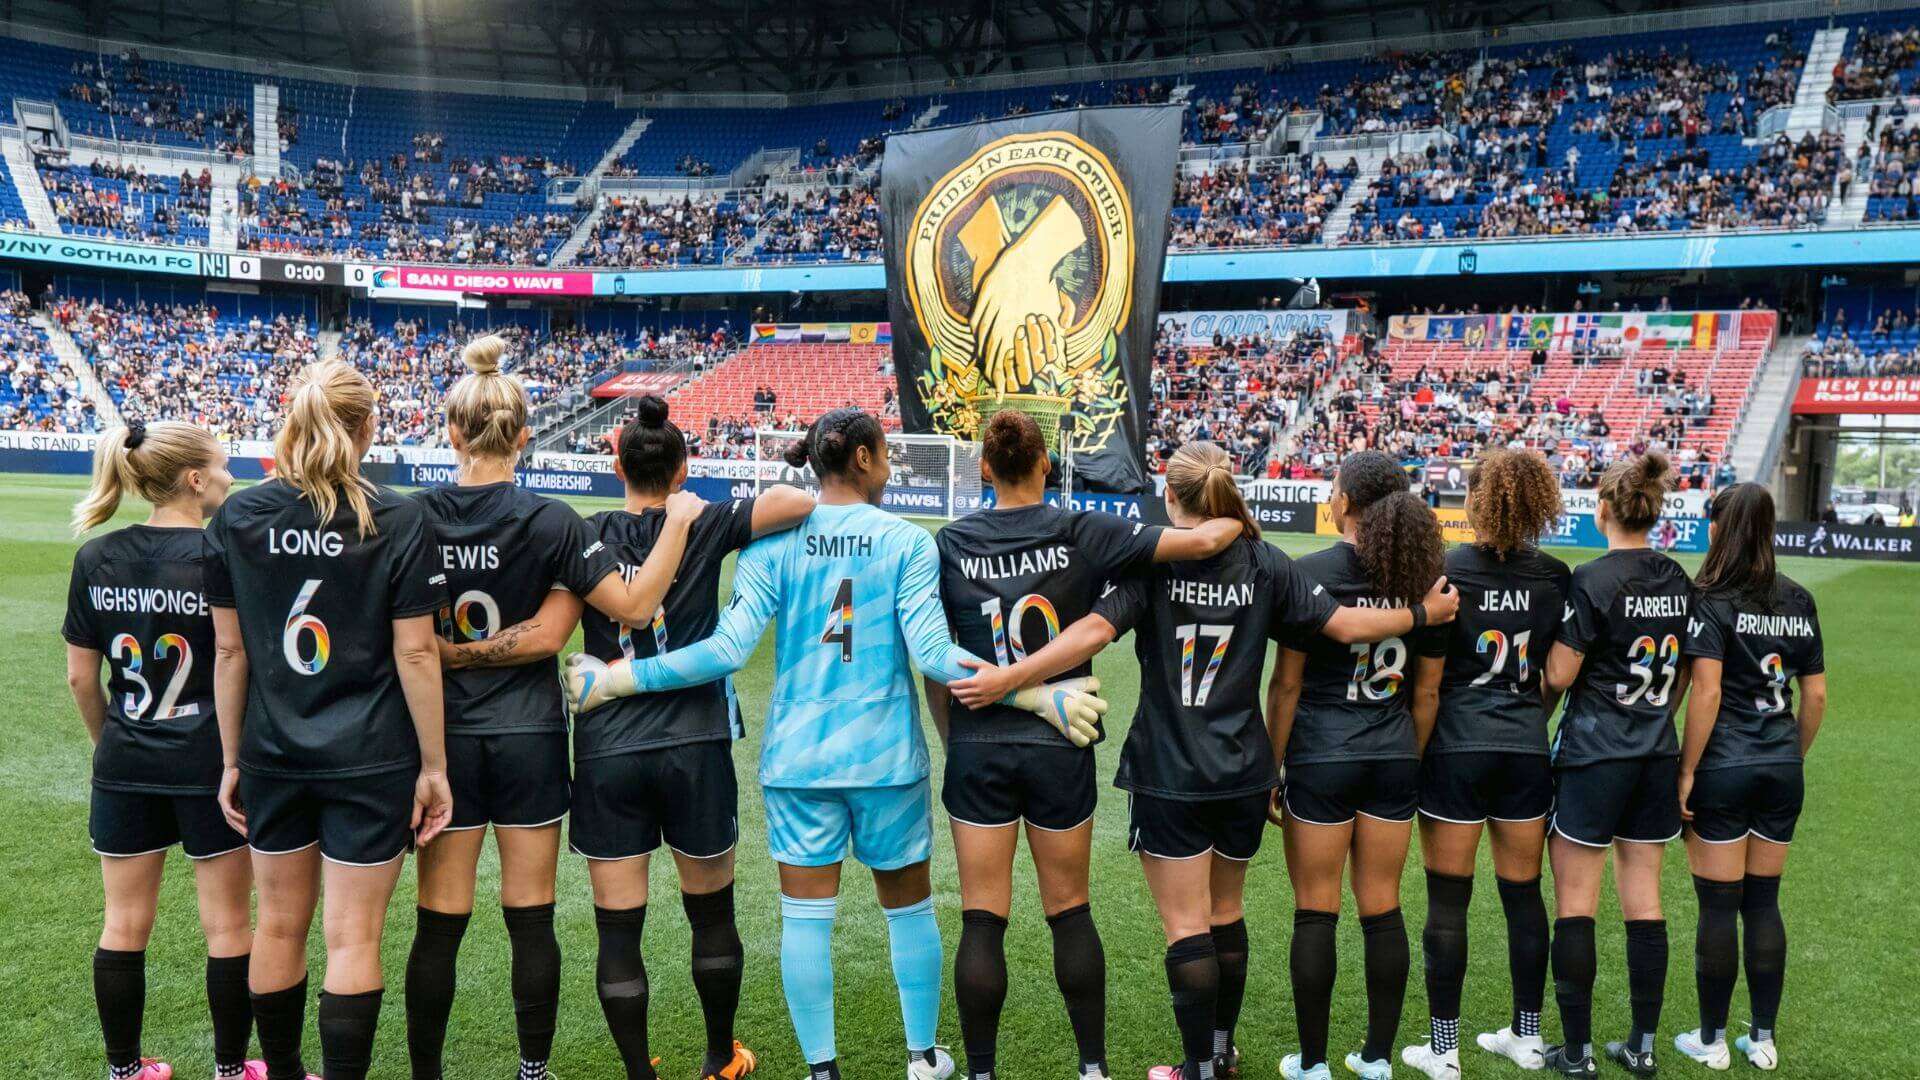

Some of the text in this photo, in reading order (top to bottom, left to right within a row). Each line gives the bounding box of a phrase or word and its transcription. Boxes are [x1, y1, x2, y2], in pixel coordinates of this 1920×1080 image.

[920, 145, 1123, 241] PRIDE IN EACH OTHER
[60, 247, 158, 267] GOTHAM
[165, 257, 193, 269] FC
[240, 260, 251, 274] 0
[284, 264, 325, 281] 0:00
[354, 269, 364, 282] 0
[407, 273, 564, 290] SAN DIEGO WAVE
[1191, 313, 1268, 338] CLOUD
[1814, 391, 1919, 402] Red Bulls
[1817, 380, 1859, 392] NEW
[31, 436, 81, 450] STAND
[570, 460, 614, 472] TOGETH
[526, 473, 593, 491] MEMBERSHIP.
[882, 493, 943, 508] @NWSL
[1253, 485, 1319, 503] JUSTICE
[1068, 499, 1141, 519] DELTA
[269, 527, 344, 557] LONG
[806, 534, 872, 557] SMITH
[1831, 533, 1912, 552] WALKER
[438, 545, 500, 570] EWIS
[960, 545, 1070, 580] WILLIAMS
[88, 585, 209, 616] NIGHSWONGE
[1478, 590, 1530, 612] JEAN
[1624, 595, 1688, 618] FARRELLY
[283, 579, 331, 676] 6
[819, 577, 854, 663] 4
[981, 593, 1061, 668] 10
[1687, 616, 1705, 639] ly
[1735, 612, 1815, 638] BRUNINHA
[1175, 623, 1236, 708] 17
[1346, 637, 1408, 701] 18
[1468, 629, 1532, 694] 21
[1615, 633, 1679, 707] 33
[111, 632, 200, 721] 32
[1755, 652, 1786, 713] 3
